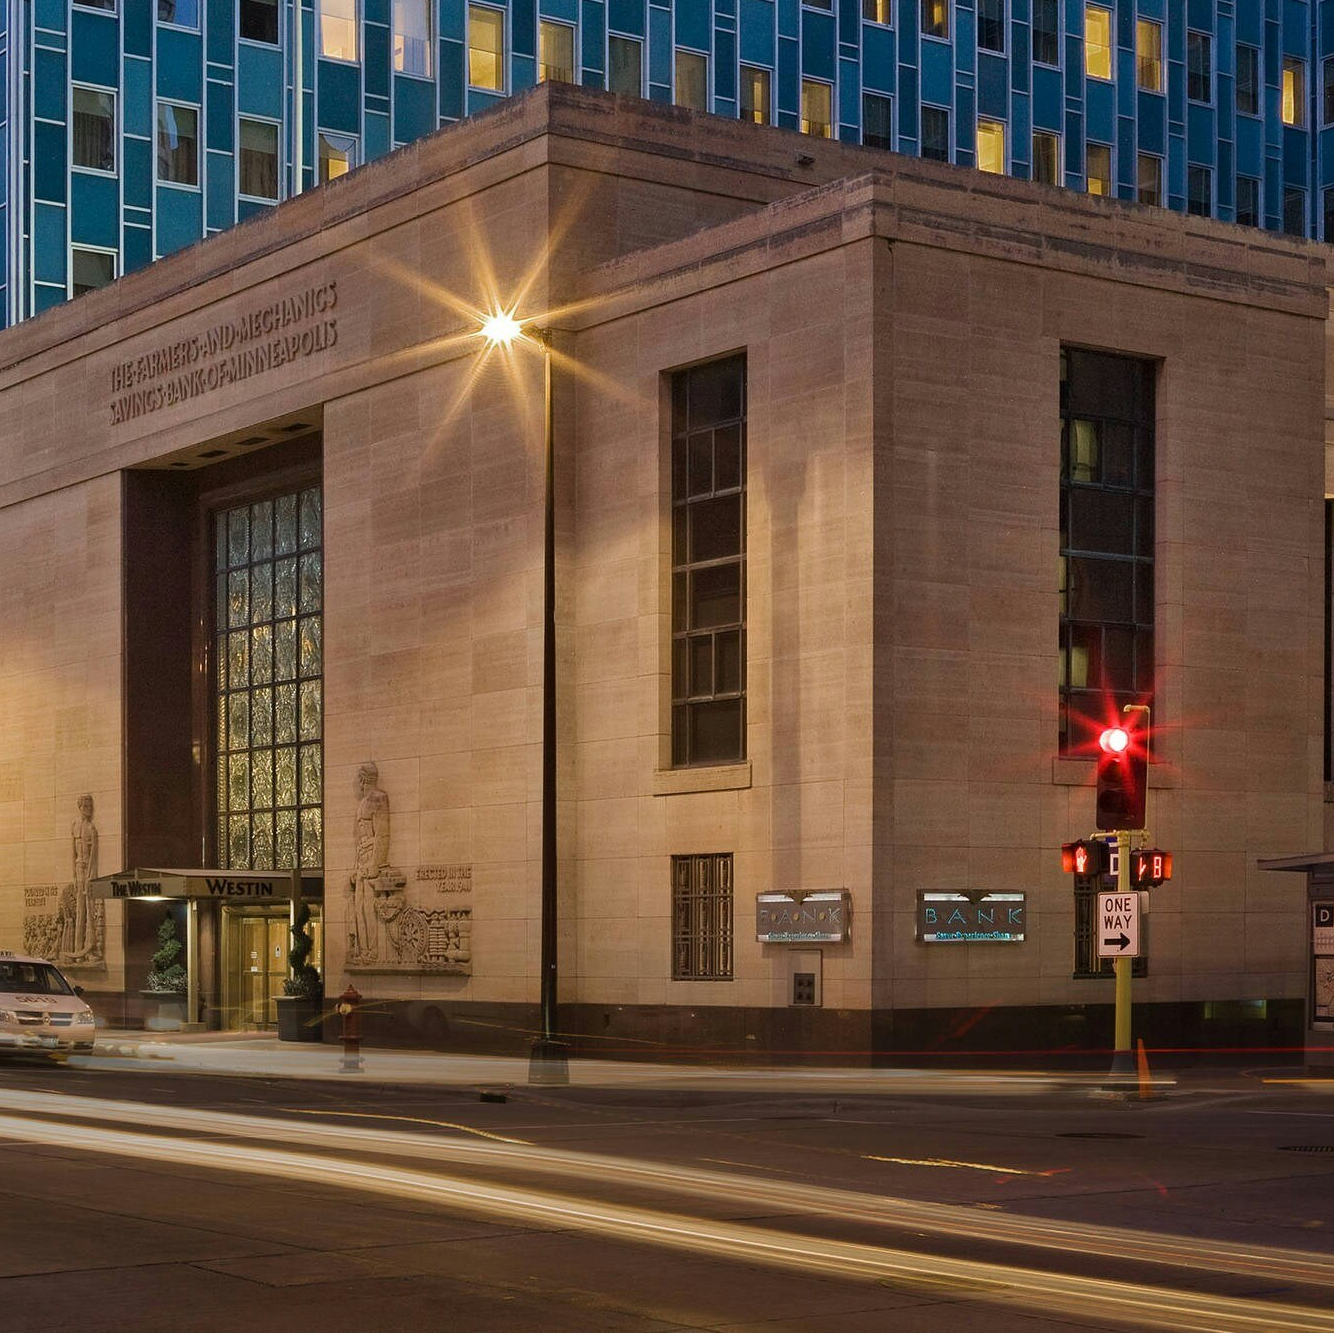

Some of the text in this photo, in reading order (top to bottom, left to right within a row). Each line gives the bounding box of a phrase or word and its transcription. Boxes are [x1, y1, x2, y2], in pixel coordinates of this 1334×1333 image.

[111, 281, 338, 394] THE FARMERS AND MECHANICS
[110, 319, 338, 426] SAVINGS BANK OF MINNEAPOLIS
[416, 867, 447, 881] ERECTED
[111, 880, 161, 898] THE WESTIN
[206, 878, 273, 896] WESTIN
[436, 881, 455, 893] YEAR
[1105, 897, 1132, 913] ONE
[925, 908, 1023, 924] BANK
[1104, 914, 1133, 930] WAY
[1320, 909, 1330, 922] D
